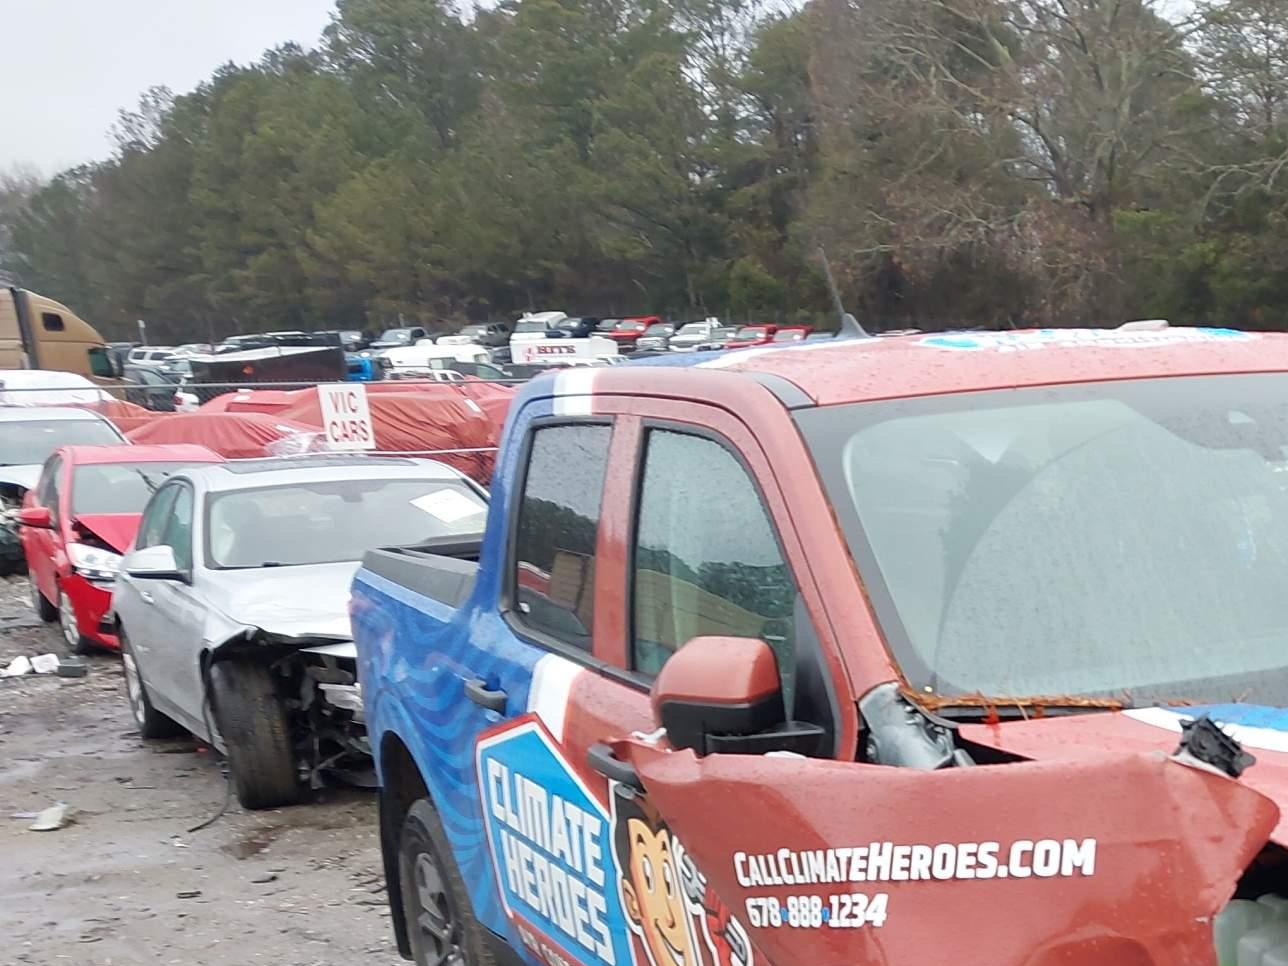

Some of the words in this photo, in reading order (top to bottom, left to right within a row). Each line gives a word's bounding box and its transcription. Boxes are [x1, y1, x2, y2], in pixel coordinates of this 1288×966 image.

[328, 391, 358, 414] VIC
[329, 420, 369, 442] CARS
[486, 756, 606, 887] CLIMATE
